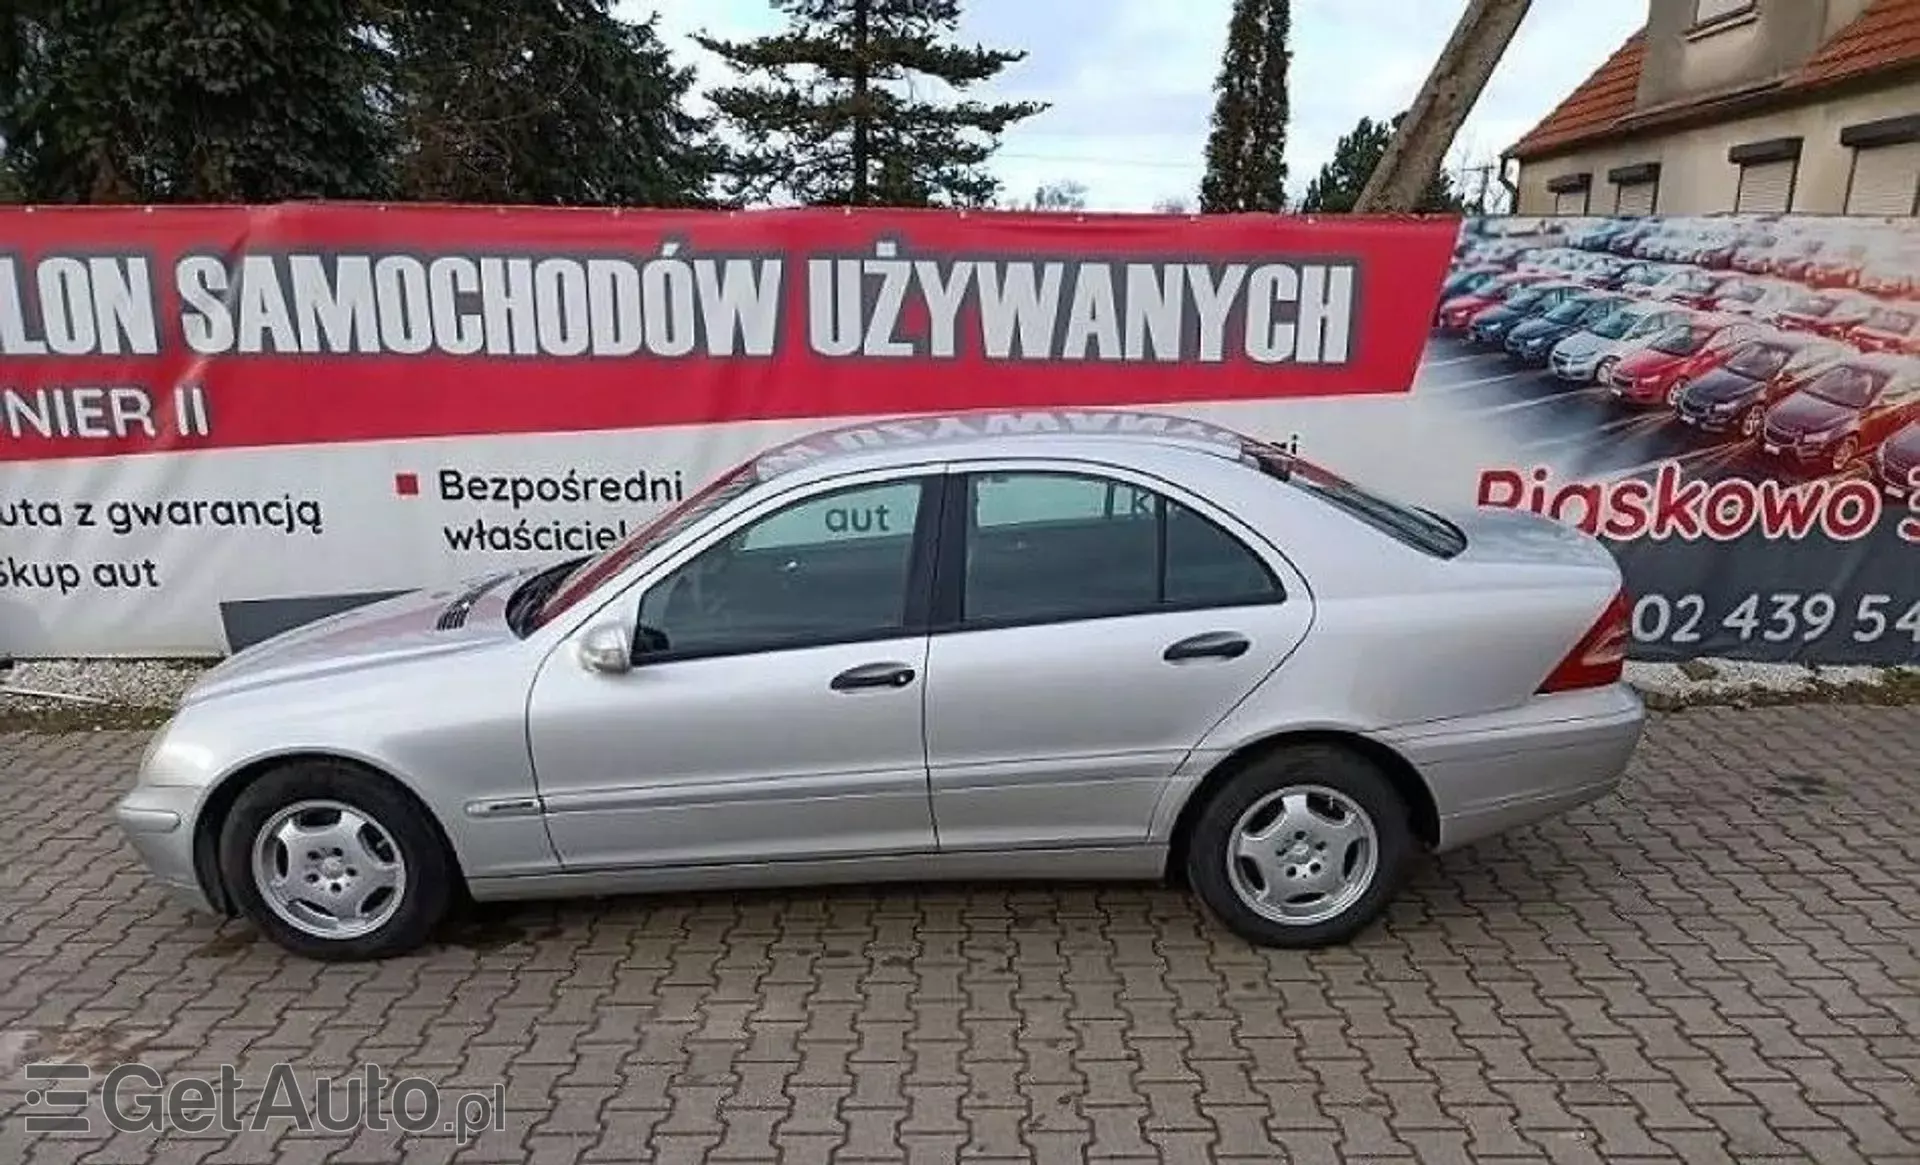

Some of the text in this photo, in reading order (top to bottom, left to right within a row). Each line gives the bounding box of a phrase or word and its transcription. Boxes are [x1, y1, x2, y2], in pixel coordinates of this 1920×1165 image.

[0, 241, 1354, 365] LON SAMOCHODÓW UŻYWANYCH
[4, 387, 156, 438] NIER
[439, 468, 682, 509] Bezpośredni
[0, 493, 323, 534] uta z gwarancją
[825, 504, 890, 532] aut
[93, 558, 160, 587] aut
[1631, 593, 1920, 642] 02 439 54
